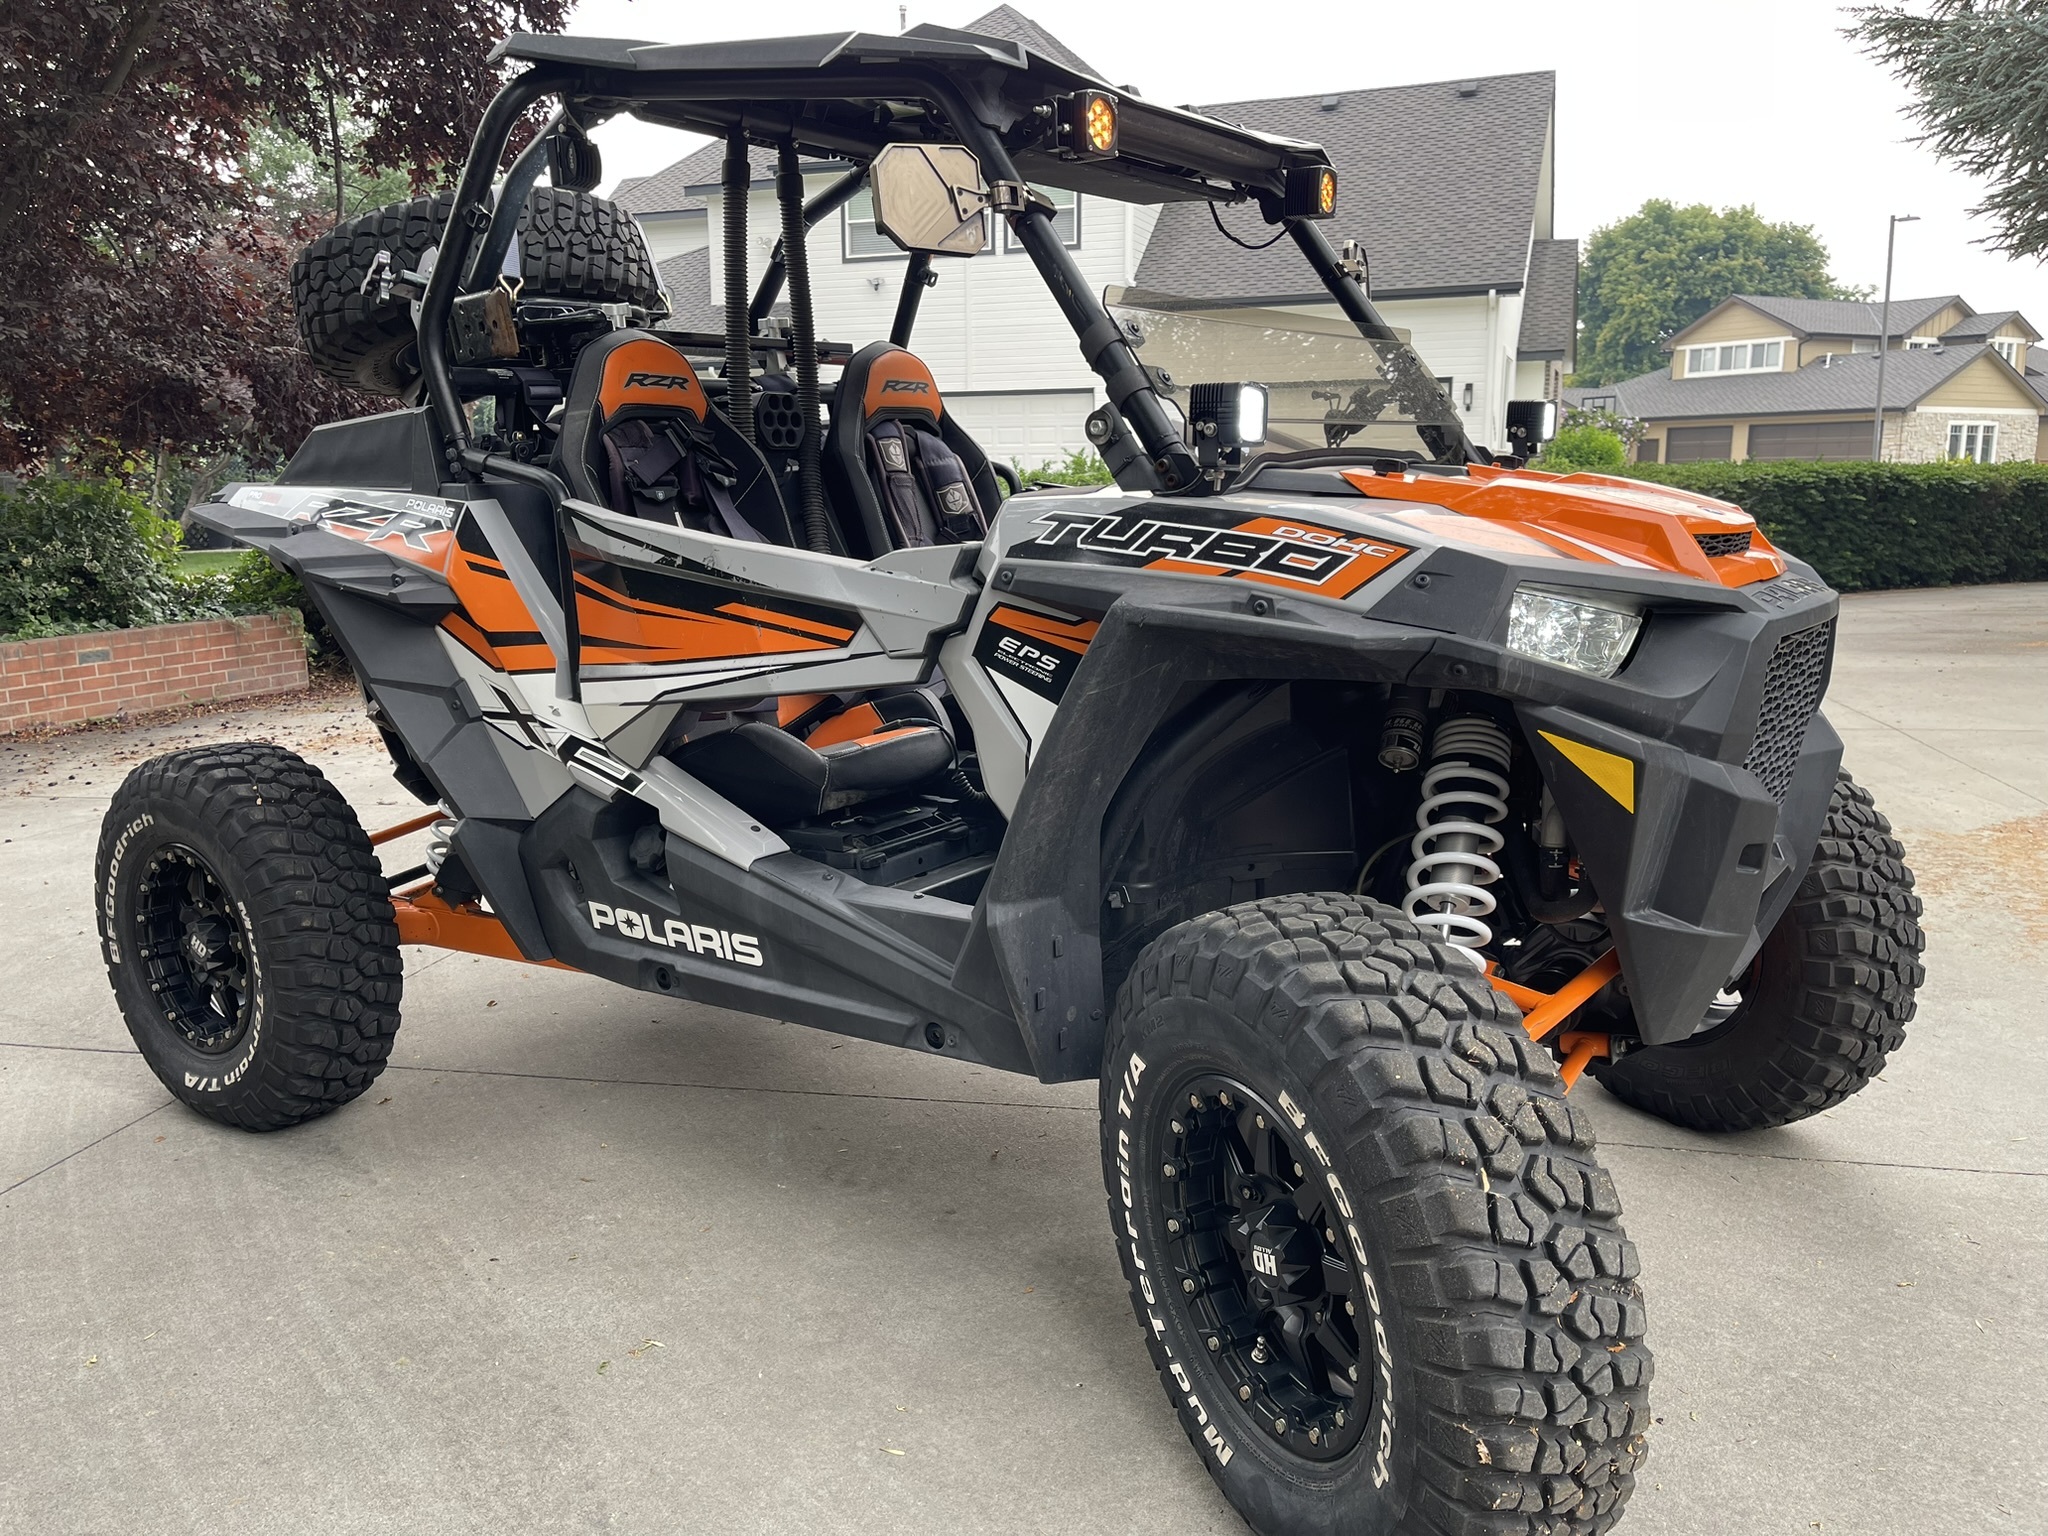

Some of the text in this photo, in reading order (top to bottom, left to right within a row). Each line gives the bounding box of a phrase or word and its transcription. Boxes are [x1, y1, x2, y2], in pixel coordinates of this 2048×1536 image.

[623, 372, 690, 391] RZR
[881, 379, 929, 394] RZR
[405, 498, 456, 519] POLARIS
[1027, 510, 1360, 586] TURBO
[1271, 526, 1400, 558] DOHC
[993, 652, 1053, 684] POWER STEERING
[998, 636, 1061, 671] EPS
[105, 813, 155, 965] BFGoodrich
[191, 935, 207, 958] HD
[587, 900, 764, 967] POLARIS
[184, 1070, 222, 1092] T/A
[1117, 1052, 1148, 1121] T/A
[1252, 1250, 1278, 1277] HD
[1116, 1129, 1234, 1467] Mud-Terrain
[1278, 1089, 1397, 1490] BFGoodrich
